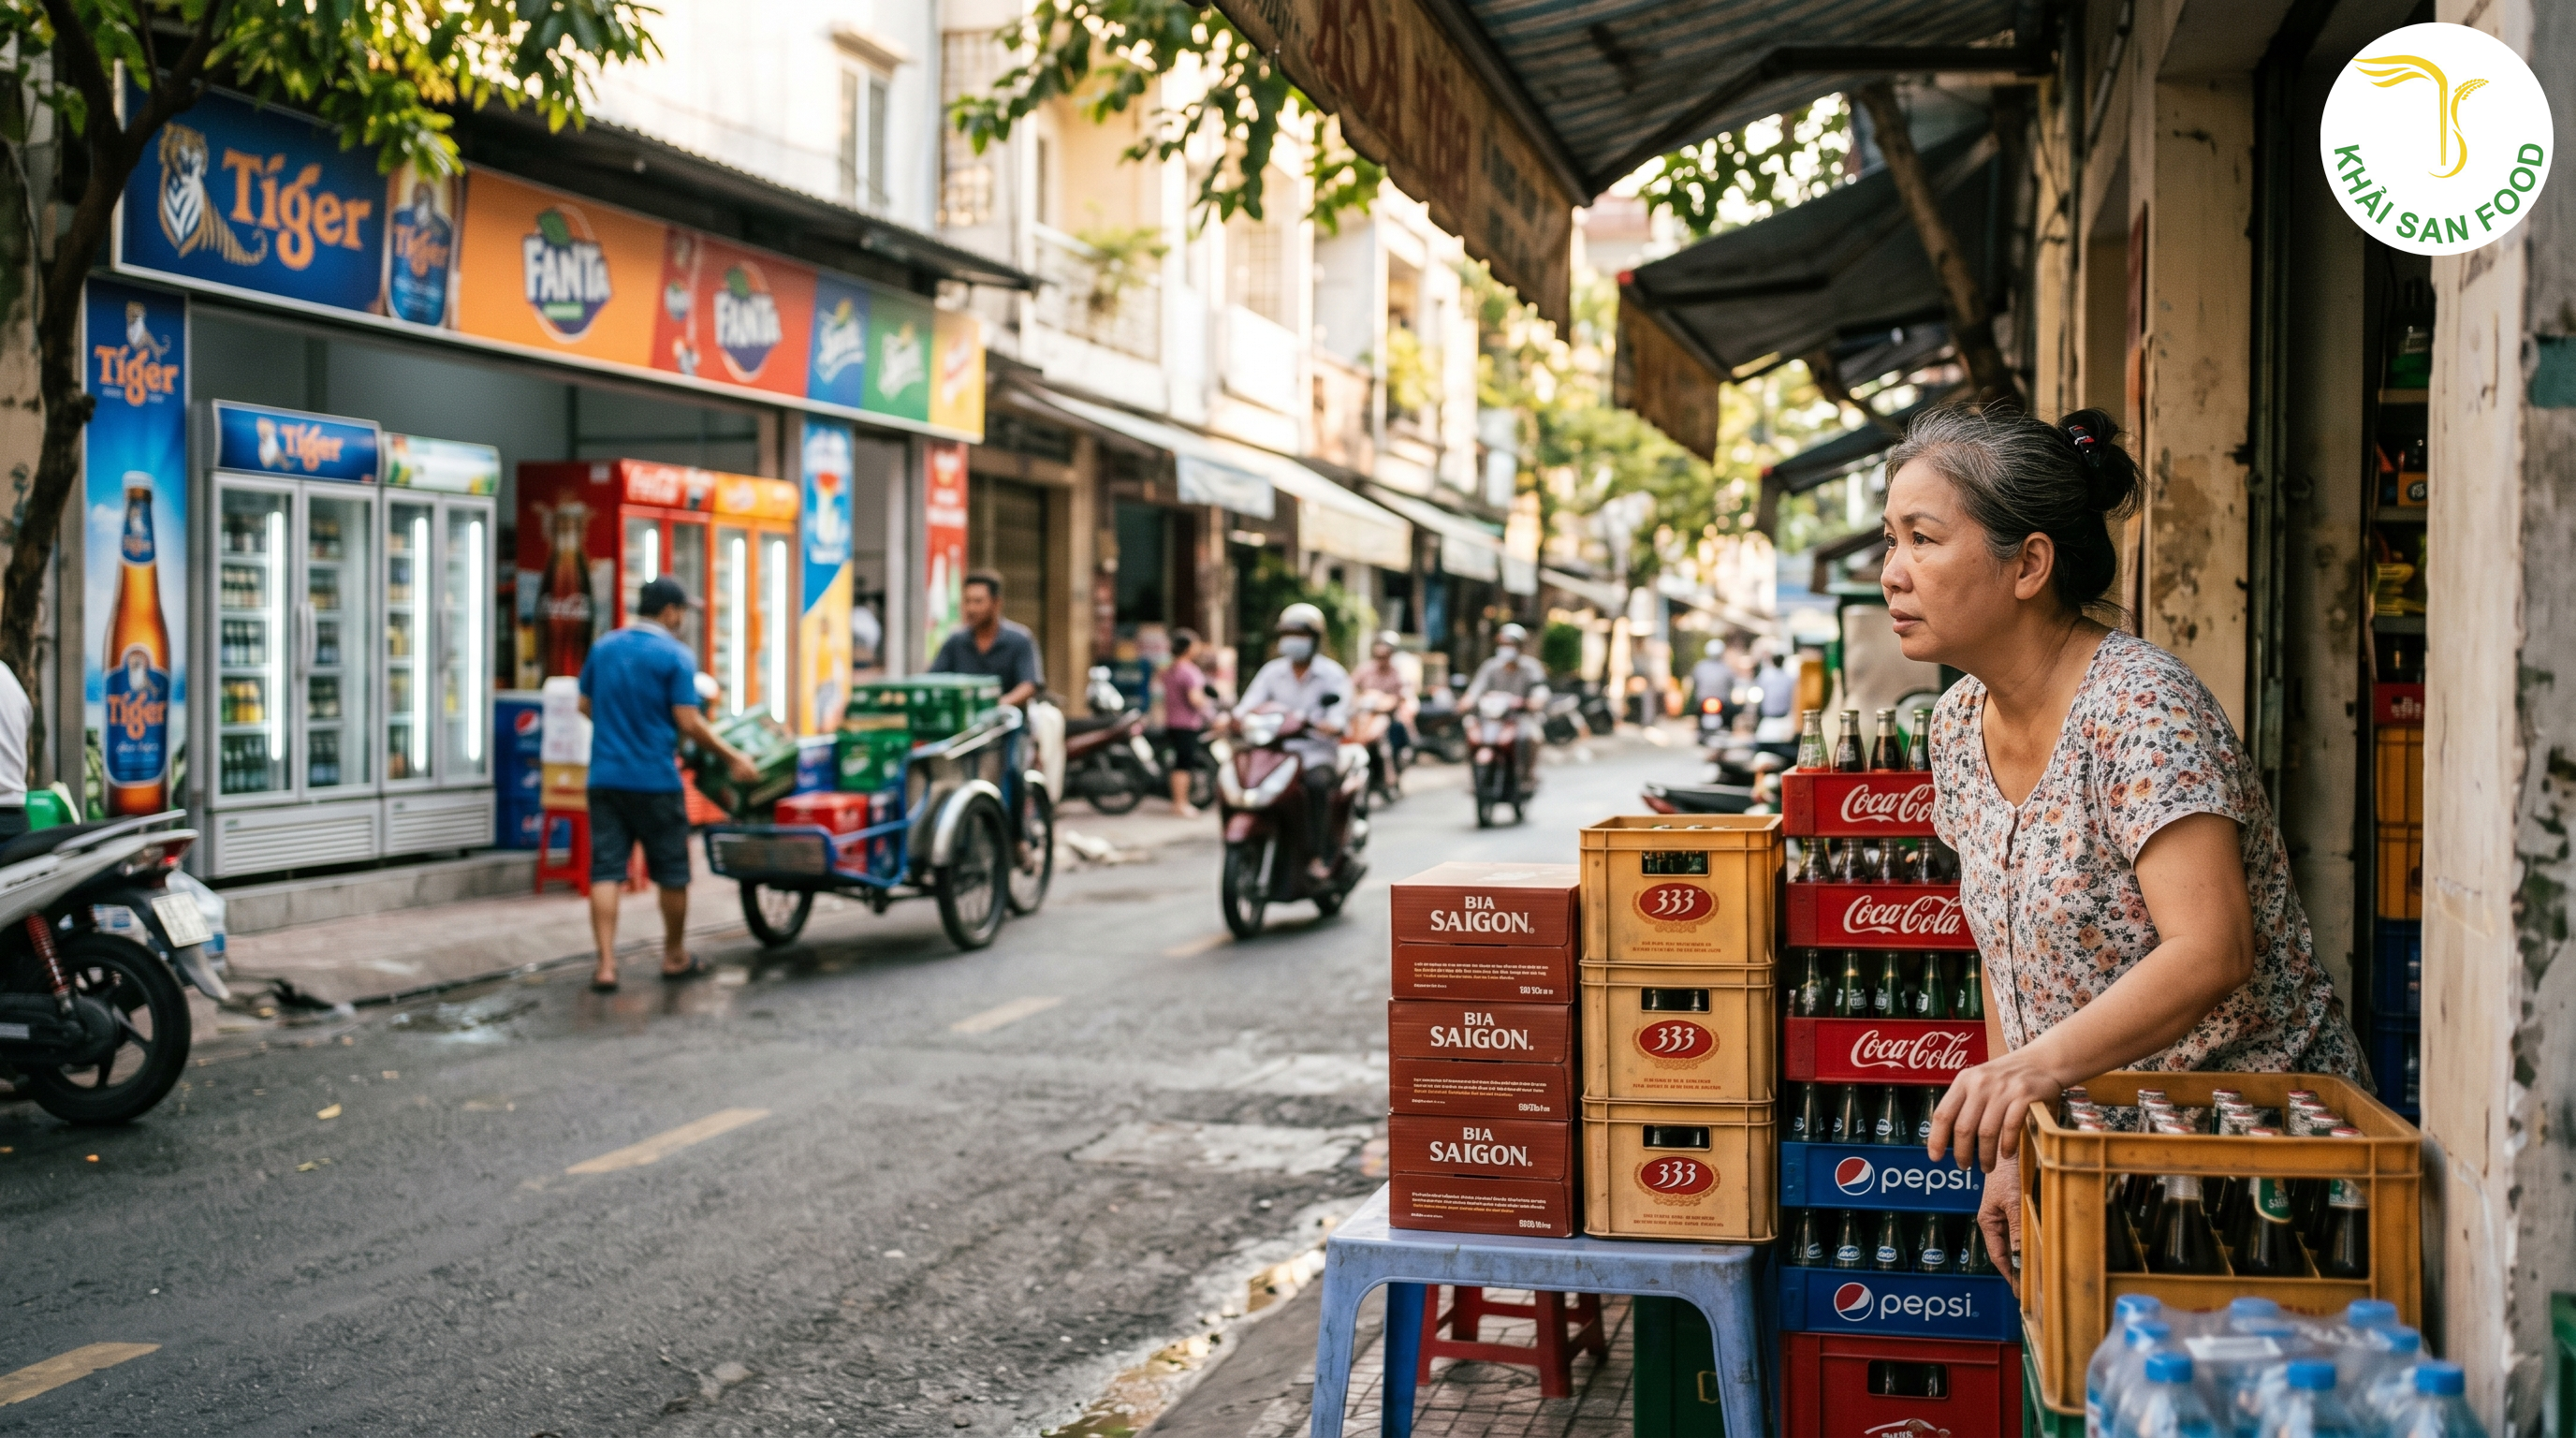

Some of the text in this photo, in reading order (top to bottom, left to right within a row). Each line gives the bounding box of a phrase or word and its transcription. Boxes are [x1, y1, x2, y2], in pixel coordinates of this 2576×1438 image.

[222, 147, 373, 271] Tiger
[523, 236, 611, 301] FANTA
[94, 345, 180, 406] Tiger
[282, 422, 344, 471] Tiger
[1465, 896, 1496, 910] BIA
[1651, 888, 1695, 916] 333
[1843, 894, 1961, 934] Coca-Cola
[1430, 909, 1530, 933] SAIGON
[1464, 1012, 1495, 1026] BIA
[1430, 1026, 1529, 1050] SAIGON
[1651, 1025, 1695, 1053] 333
[1851, 1029, 1974, 1070] Coca-Cola
[1463, 1127, 1494, 1141] BIA
[1429, 1141, 1528, 1167] SAIGON
[1653, 1161, 1696, 1189] 333
[1881, 1167, 1971, 1196] pepsi
[1881, 1292, 1971, 1321] pepsi
